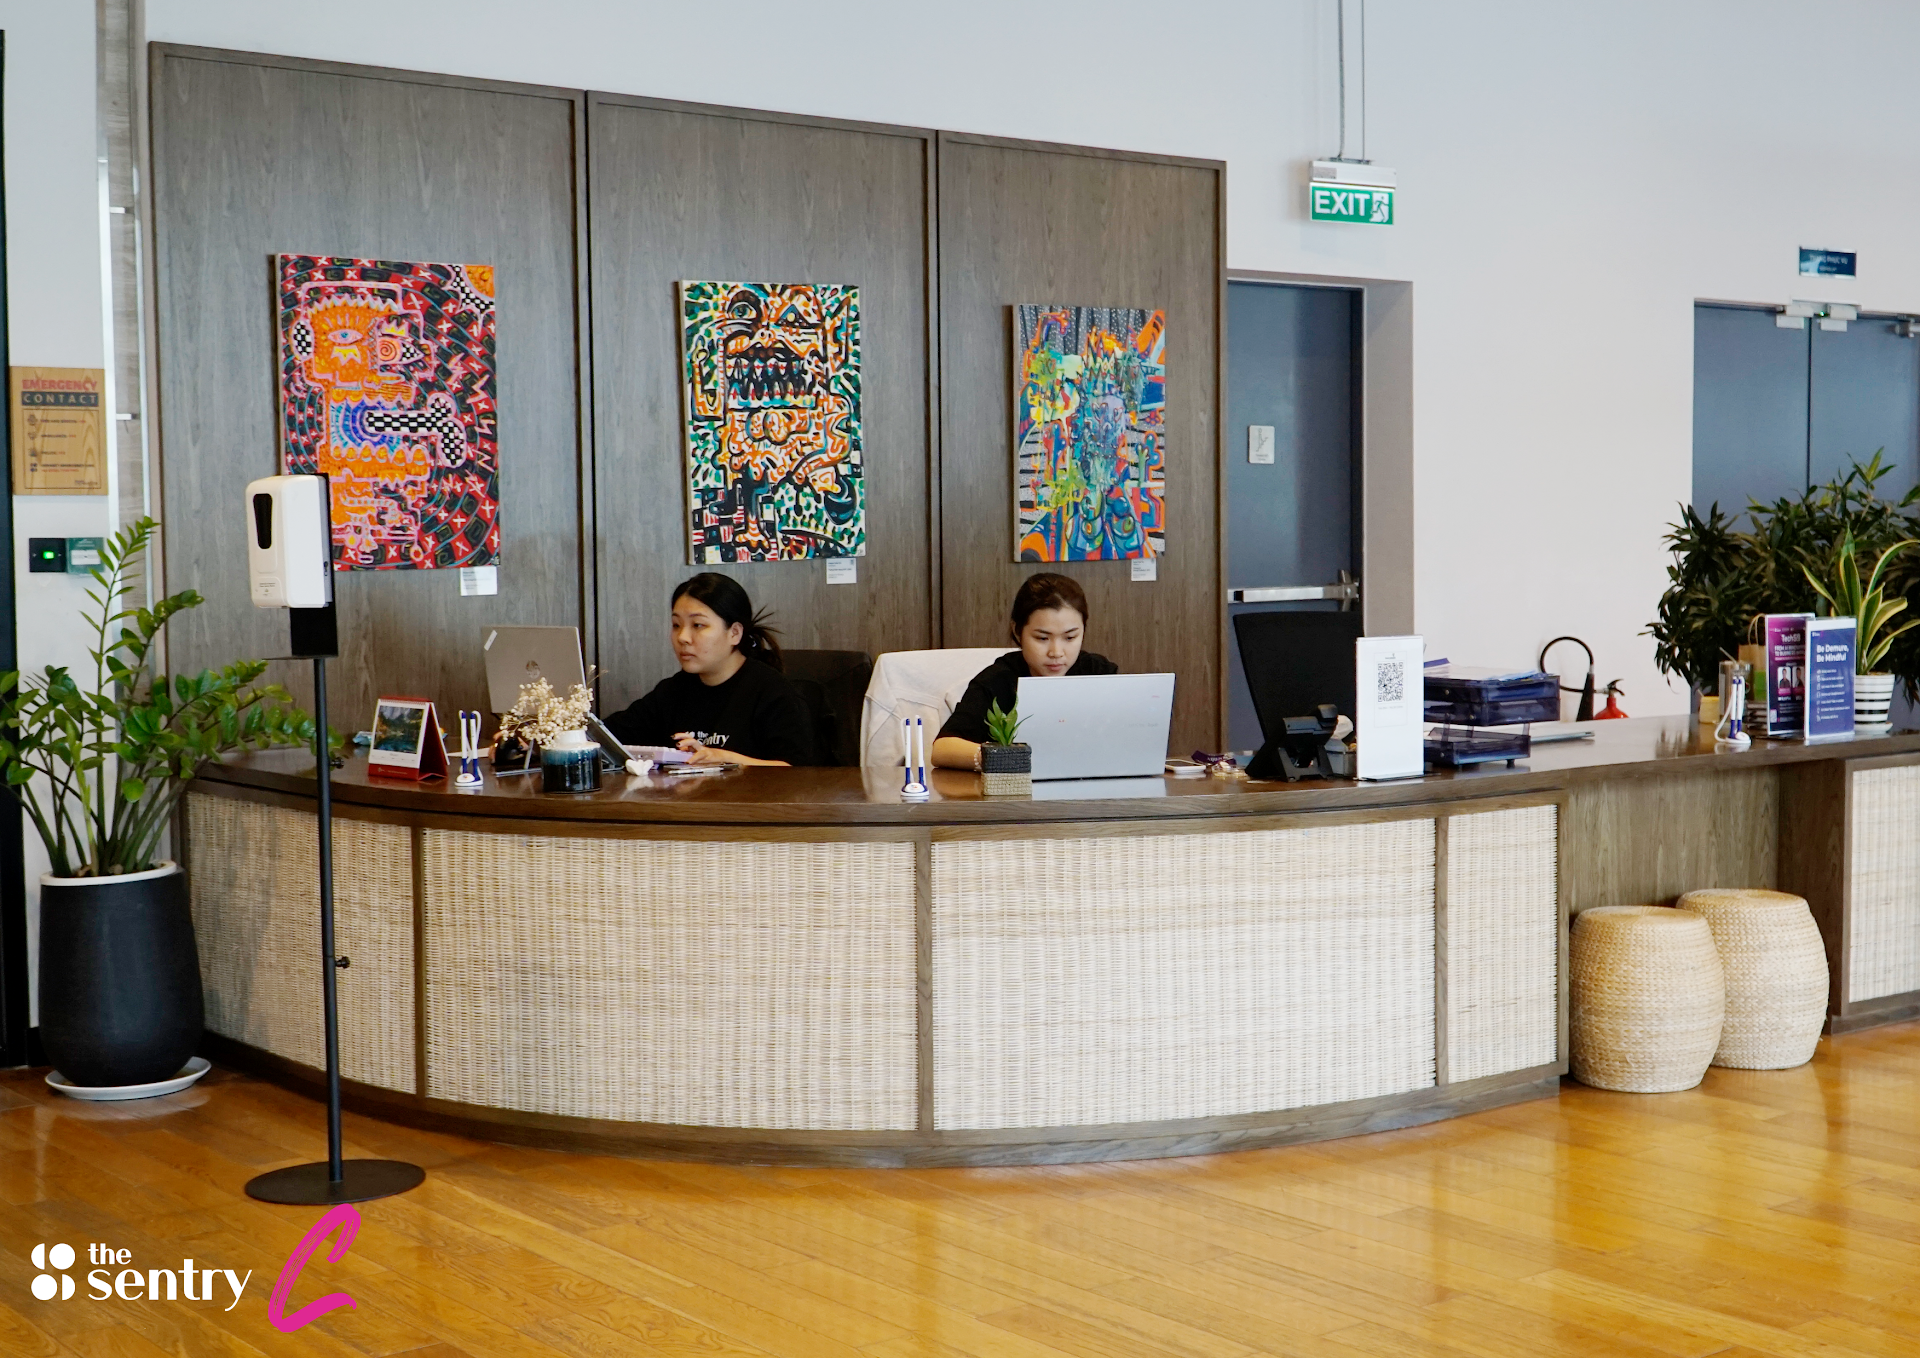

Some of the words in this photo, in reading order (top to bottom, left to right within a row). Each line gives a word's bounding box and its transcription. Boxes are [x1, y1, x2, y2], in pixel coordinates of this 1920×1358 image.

[1315, 190, 1370, 216] EXIT
[22, 379, 97, 391] EMERGENCY
[23, 393, 97, 404] CONTACT
[1816, 644, 1825, 653] Be
[1825, 644, 1849, 653] Demure,
[1816, 653, 1825, 662] Be
[1825, 653, 1846, 662] Mindful
